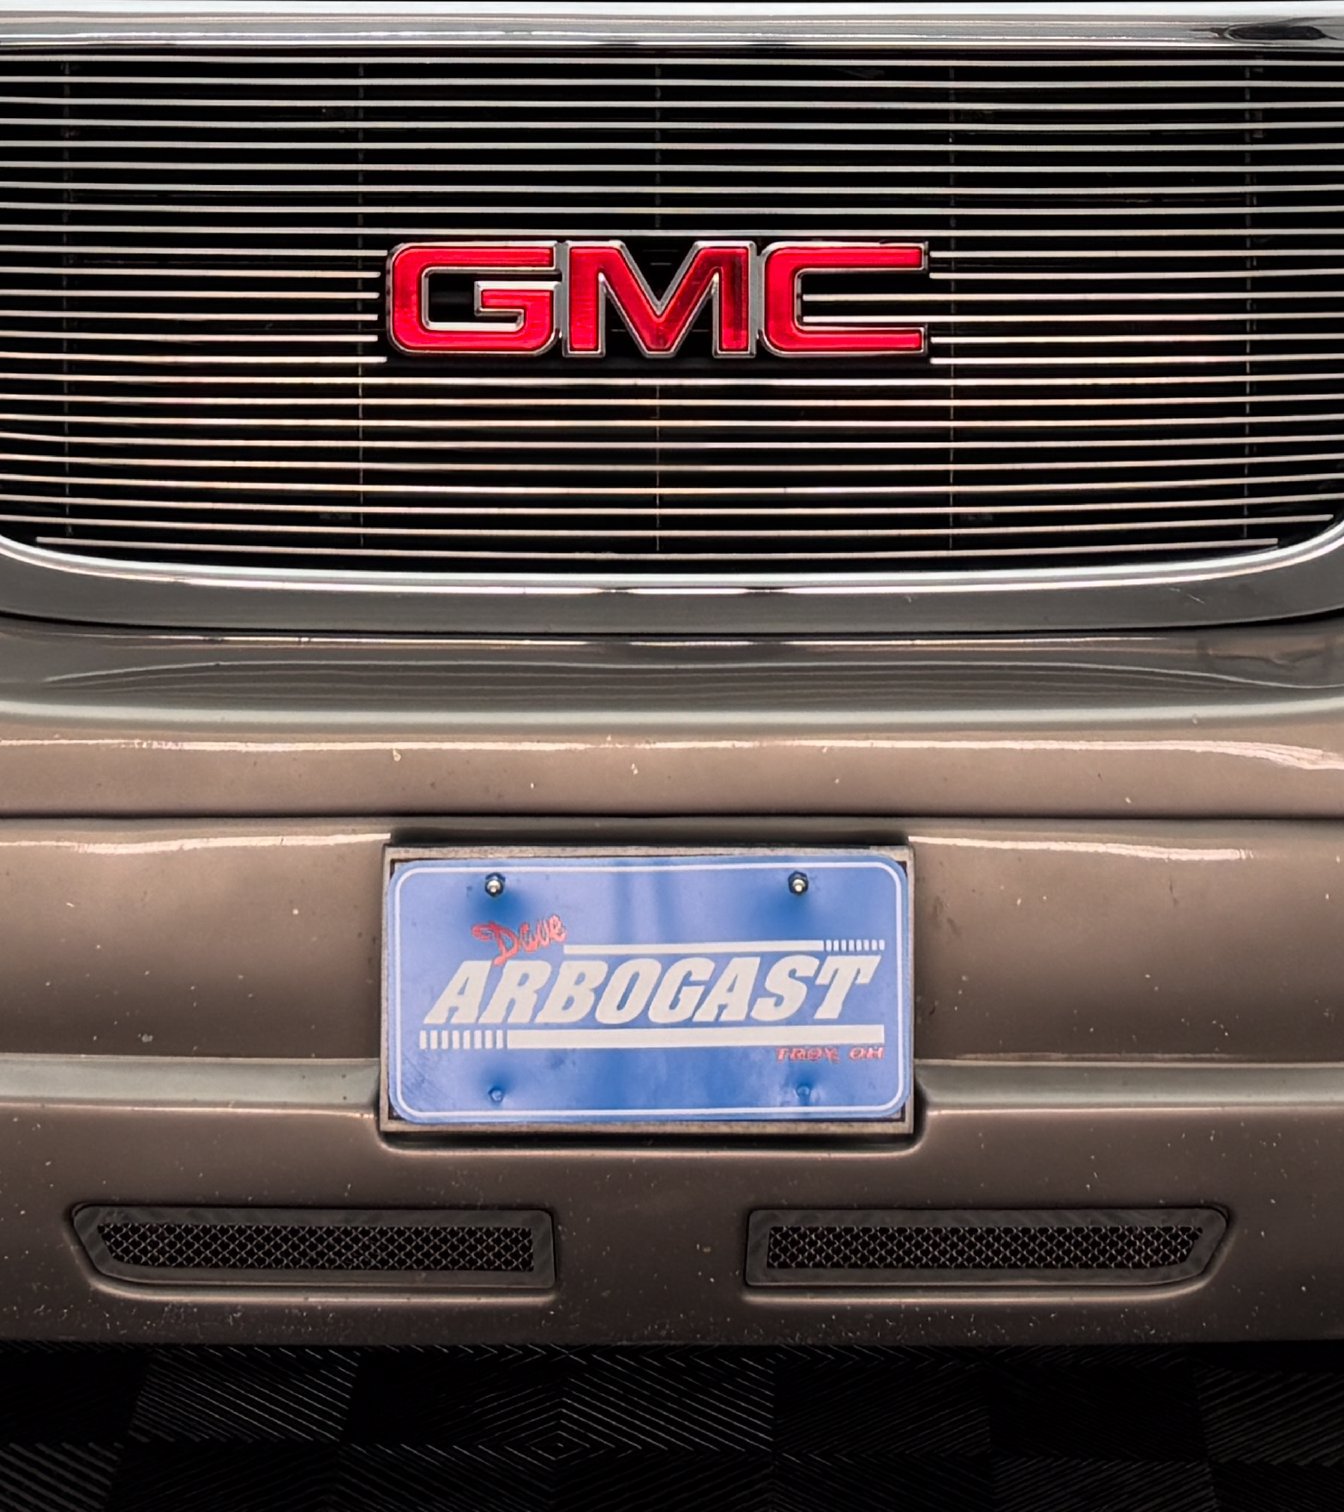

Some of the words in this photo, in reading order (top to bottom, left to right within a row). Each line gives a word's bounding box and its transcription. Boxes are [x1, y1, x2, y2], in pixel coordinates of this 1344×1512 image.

[386, 240, 928, 359] GMC
[471, 914, 567, 966] Dave
[424, 954, 883, 1025] ARBOGAST
[849, 1046, 884, 1060] OH
